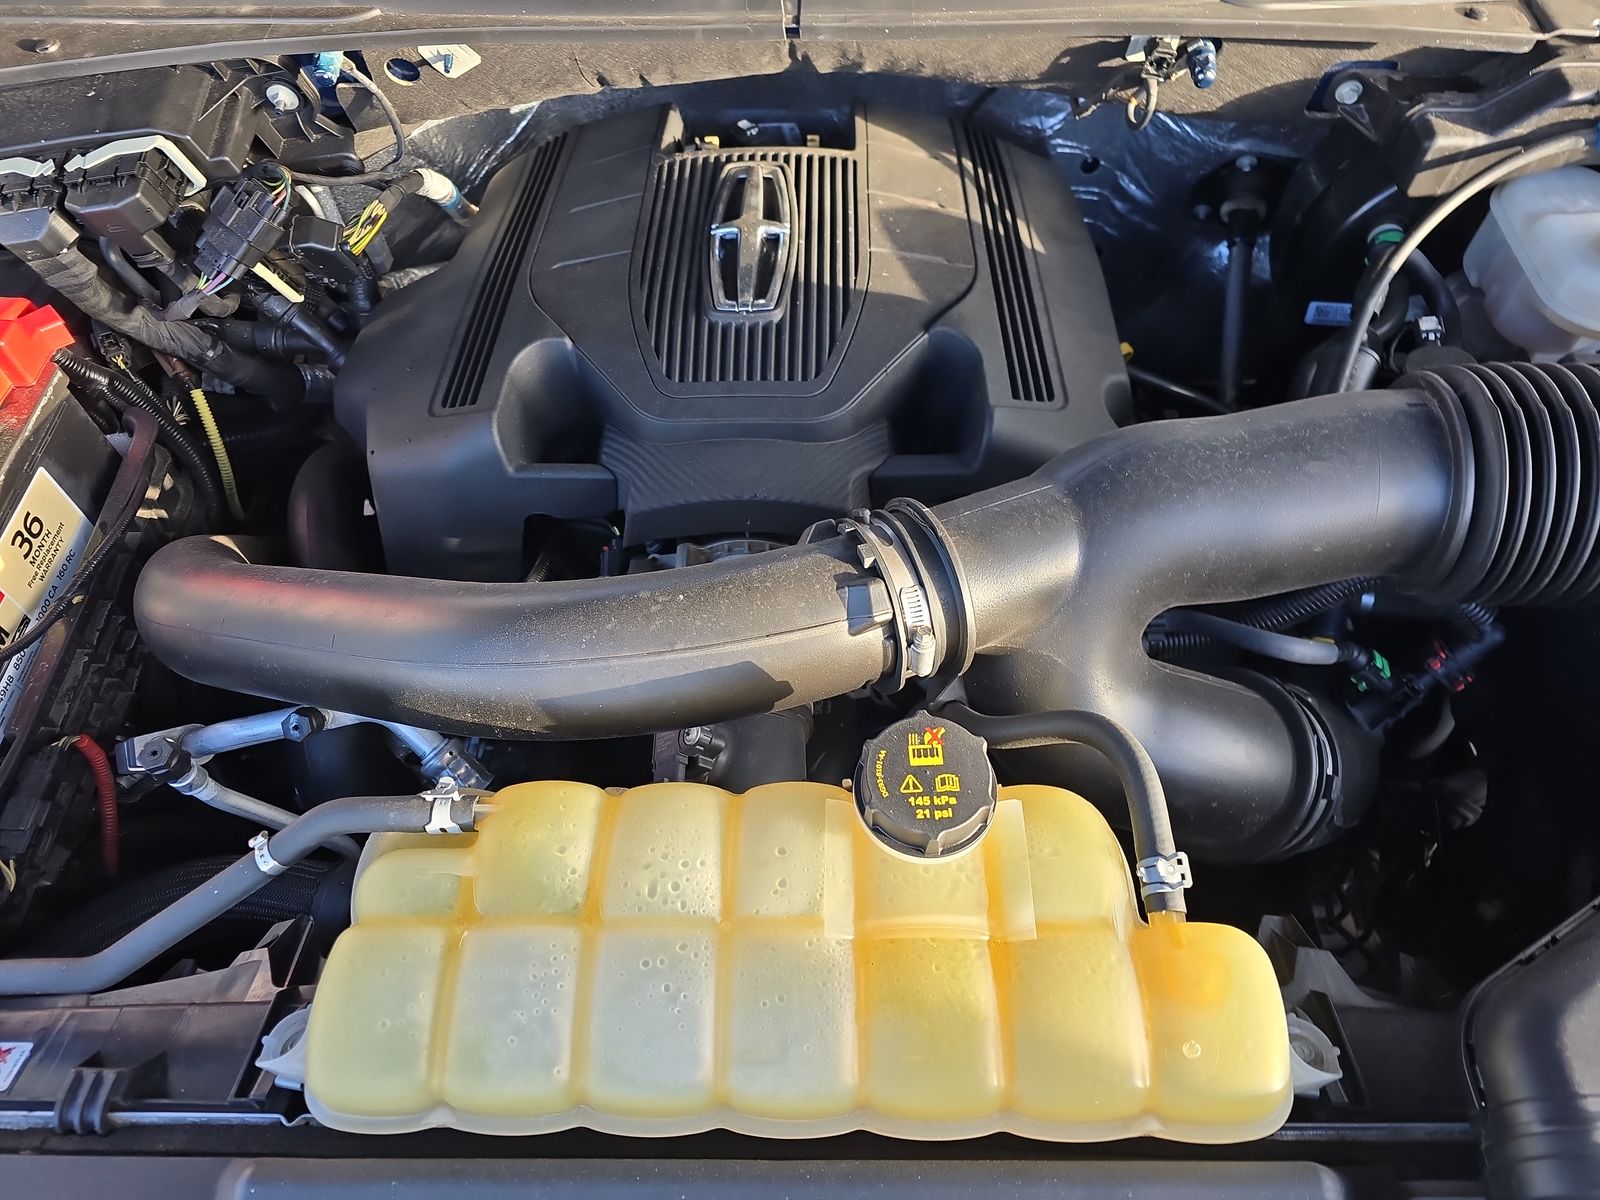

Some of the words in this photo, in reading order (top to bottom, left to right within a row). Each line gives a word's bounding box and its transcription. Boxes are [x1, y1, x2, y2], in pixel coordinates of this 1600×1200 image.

[11, 510, 44, 560] 36
[27, 568, 40, 589] Free
[36, 521, 65, 571] Replacement
[29, 528, 53, 568] MONTH
[39, 536, 65, 582] WARRANTY
[36, 599, 51, 622] 1000
[48, 584, 59, 601] CA
[56, 563, 68, 581] 160
[65, 548, 76, 565] RC
[908, 796, 931, 806] 145
[933, 795, 957, 806] kPa
[916, 808, 930, 819] 21
[934, 808, 953, 820] psi
